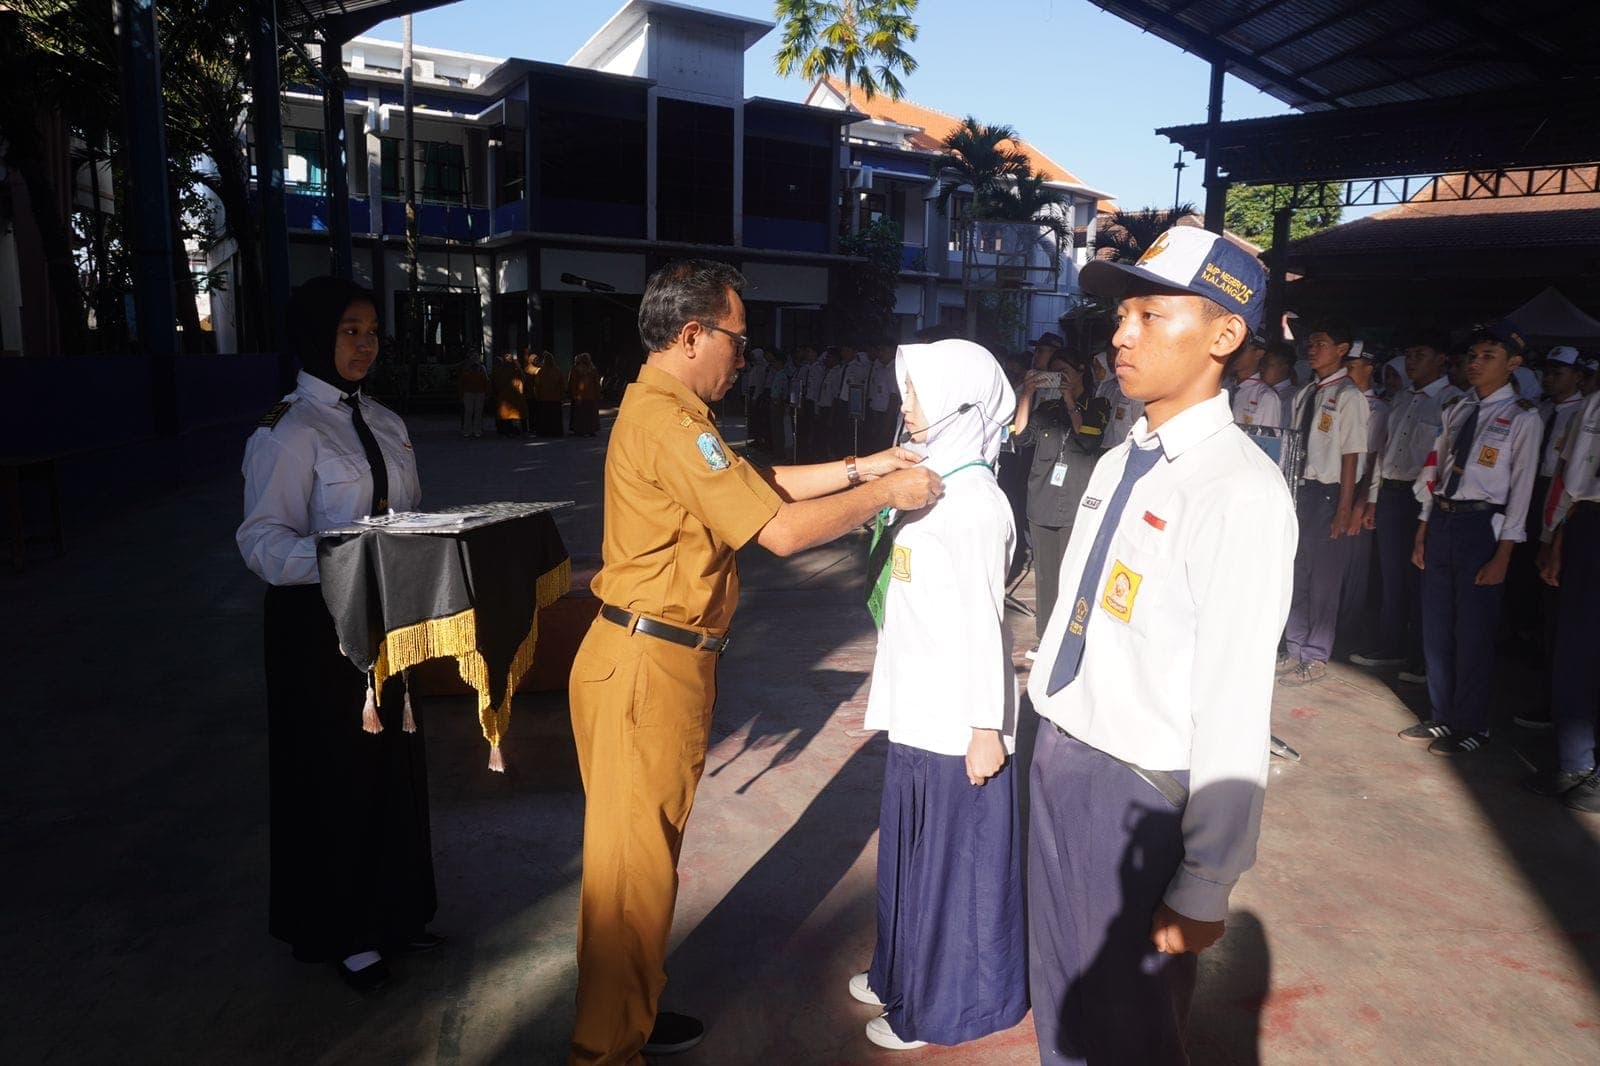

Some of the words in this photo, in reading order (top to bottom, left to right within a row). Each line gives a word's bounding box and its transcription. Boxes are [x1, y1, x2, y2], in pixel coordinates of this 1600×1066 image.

[1201, 271, 1240, 297] MALANG
[1220, 271, 1243, 289] NEGERI
[1236, 285, 1253, 304] 25
